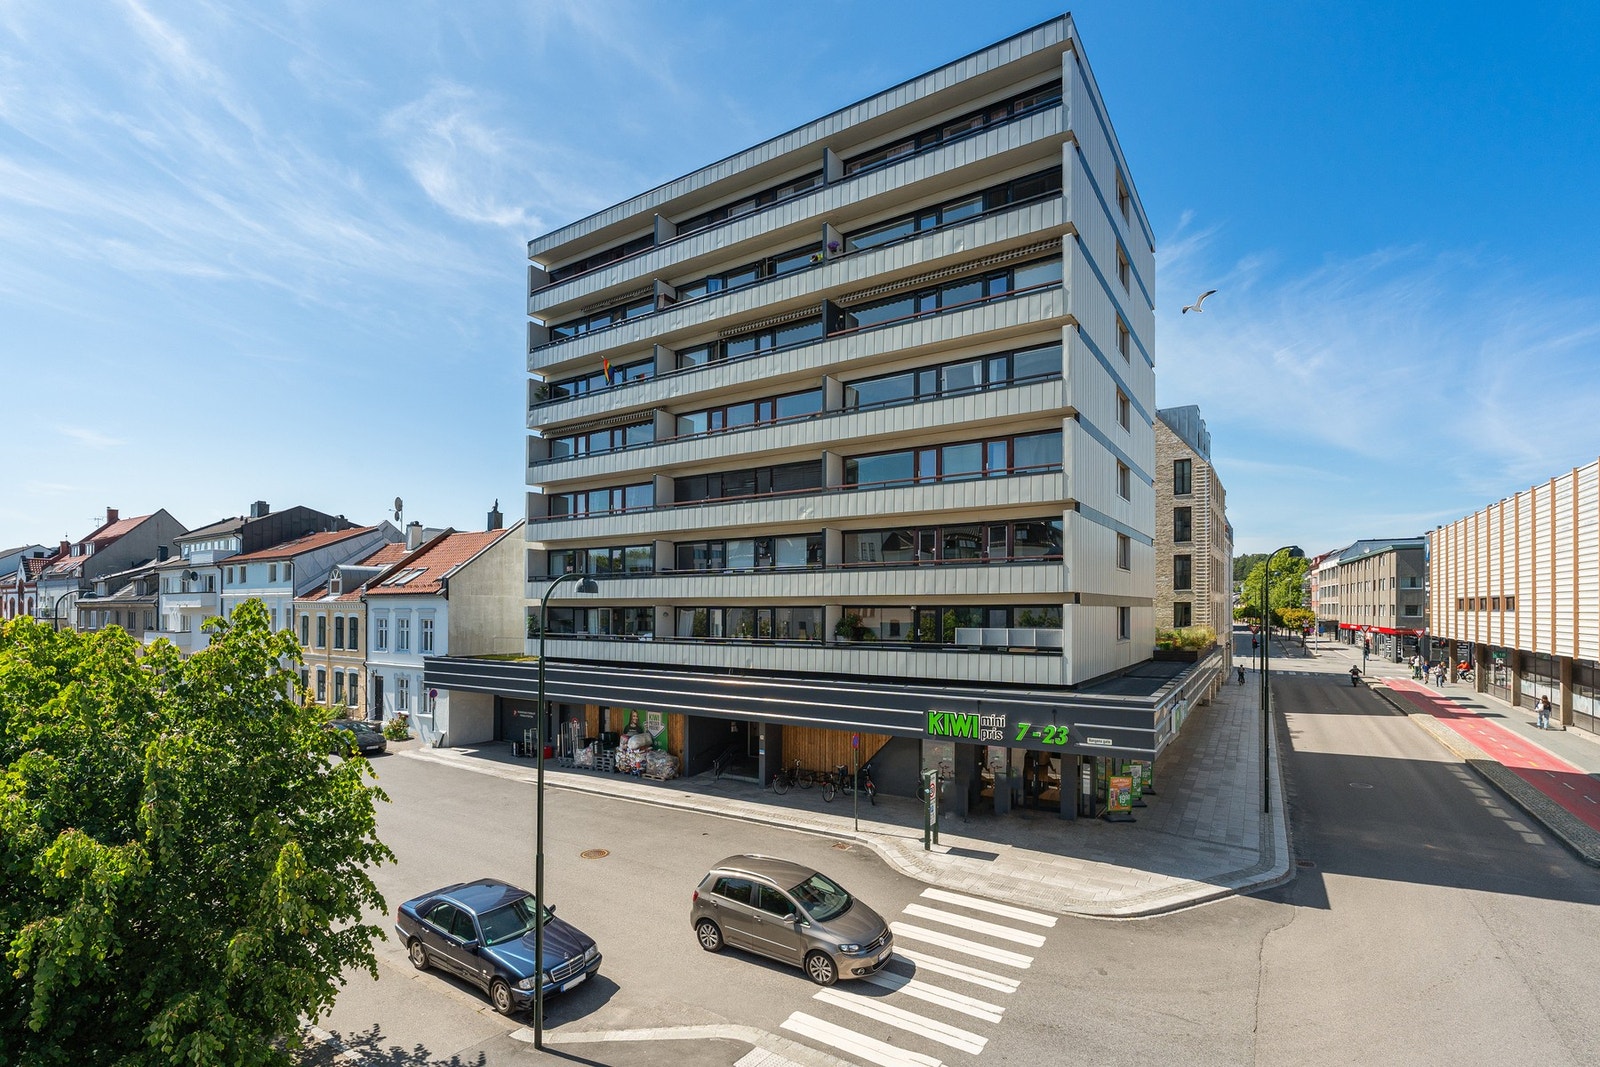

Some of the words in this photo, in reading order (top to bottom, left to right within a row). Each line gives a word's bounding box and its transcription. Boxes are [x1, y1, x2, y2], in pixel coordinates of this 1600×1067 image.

[928, 710, 980, 739] KIWI
[980, 714, 1006, 727] mini
[980, 727, 1003, 741] pris
